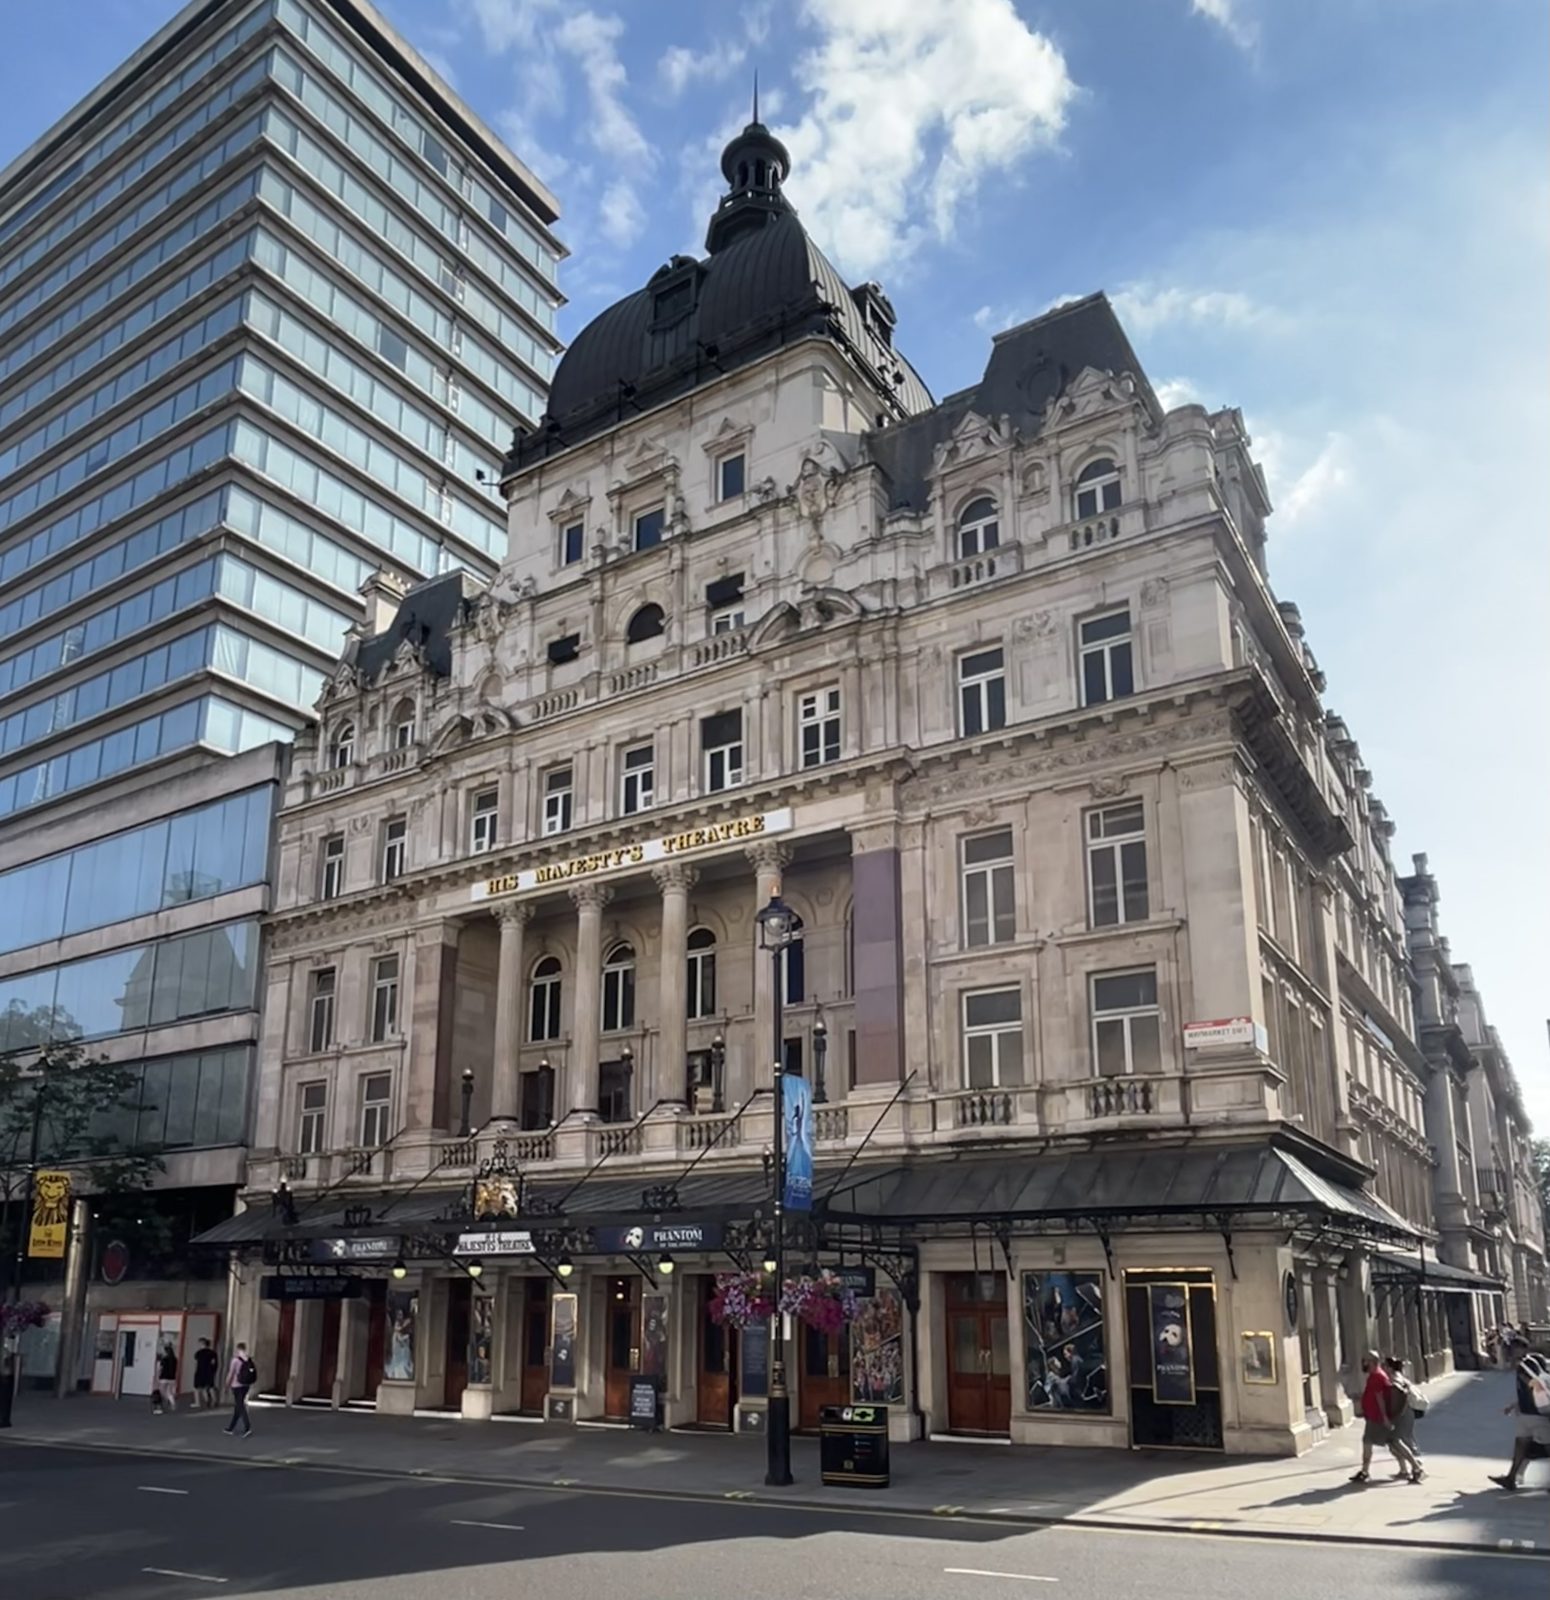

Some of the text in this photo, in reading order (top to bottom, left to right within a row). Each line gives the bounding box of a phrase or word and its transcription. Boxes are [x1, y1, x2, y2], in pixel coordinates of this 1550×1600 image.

[487, 815, 766, 895] HIS MAJESTY'S THEATRE
[653, 1229, 703, 1242] PHANTOM
